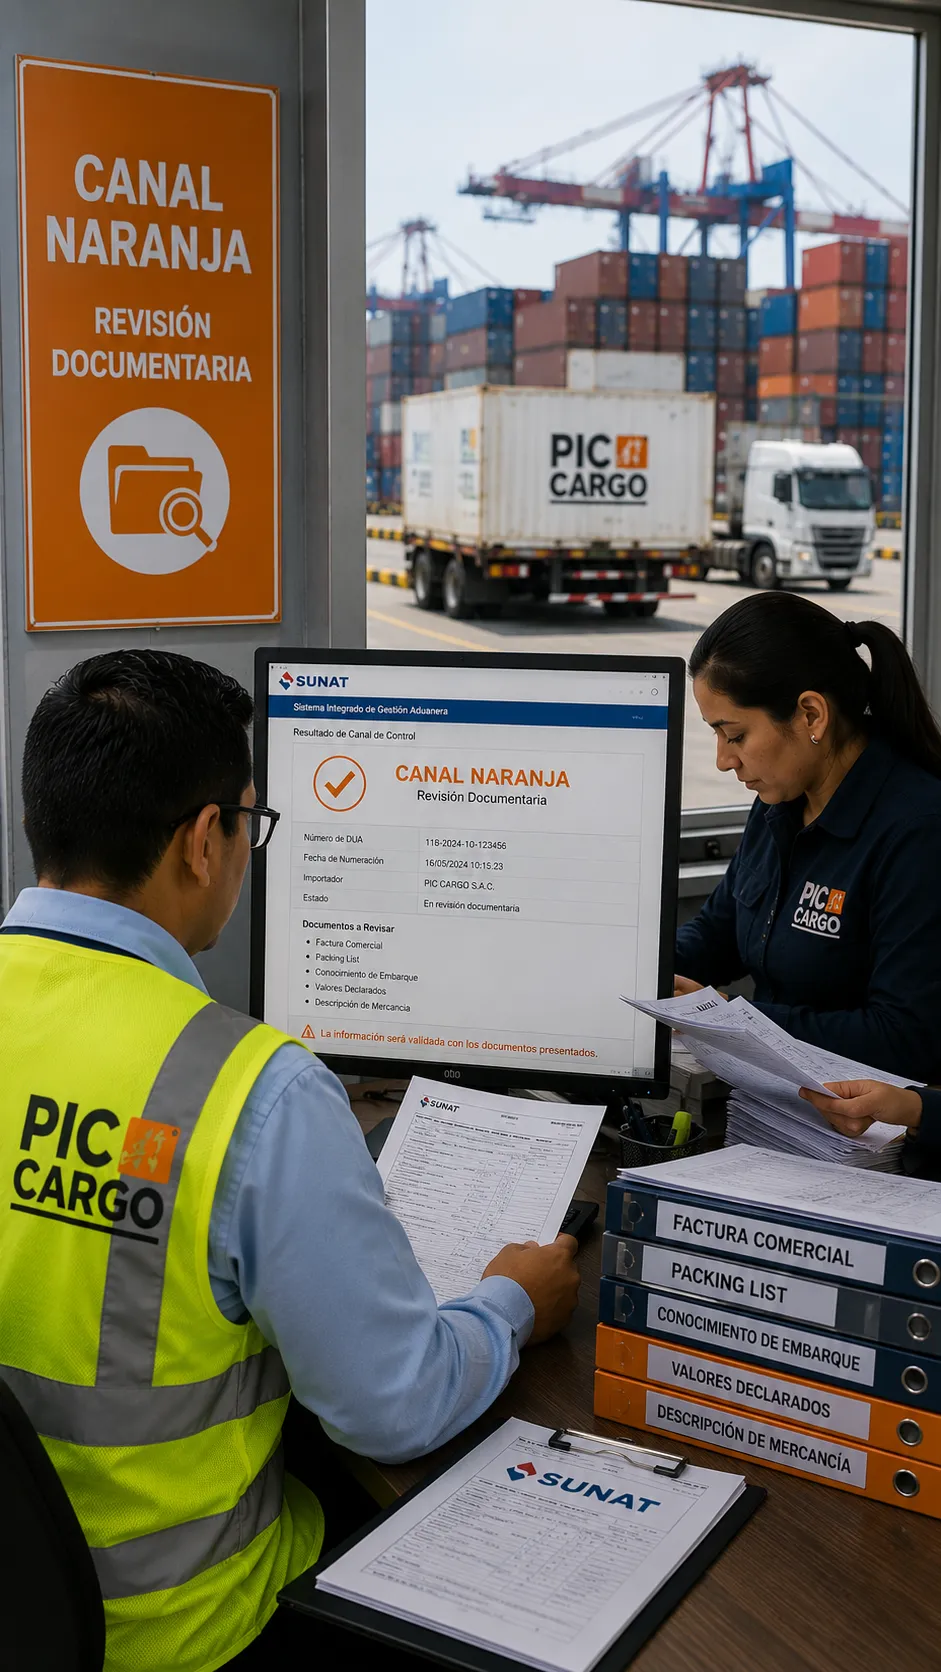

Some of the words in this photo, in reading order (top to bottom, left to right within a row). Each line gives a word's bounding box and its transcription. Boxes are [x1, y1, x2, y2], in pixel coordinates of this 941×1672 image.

[75, 154, 223, 212] CANAL
[47, 215, 252, 274] NARANJA
[95, 304, 210, 339] REVISIÓN
[52, 349, 252, 382] DOCUMENTARIA
[551, 433, 611, 468] PIC
[550, 472, 648, 498] CARGO
[296, 675, 349, 688] SUNAT
[293, 702, 325, 712] Sistema
[326, 703, 364, 714] Integrado
[365, 704, 376, 713] de
[410, 706, 448, 716] Aduanera
[294, 728, 334, 738] Resultado
[336, 729, 346, 738] de
[348, 730, 372, 739] Canal
[374, 731, 384, 740] de
[386, 731, 416, 740] Control
[395, 764, 464, 784] CANAL
[471, 768, 570, 788] NARANJA
[417, 790, 464, 802] Revisión
[468, 792, 547, 806] Documentaria
[304, 833, 333, 842] Número
[334, 835, 344, 843] de
[346, 836, 363, 844] DUA
[304, 854, 326, 862] Fecha
[328, 855, 338, 863] de
[340, 855, 384, 864] Numeración
[425, 859, 468, 869] 16/05/2024
[303, 874, 343, 884] Importador
[424, 880, 438, 888] PIC
[439, 880, 470, 889] CARGO
[472, 882, 495, 891] S.A.C.
[303, 894, 329, 902] Estado
[799, 881, 829, 910] PIC
[424, 900, 434, 908] En
[436, 900, 465, 910] revisión
[467, 902, 520, 913] documentaria
[302, 920, 354, 930] Documentos
[363, 923, 394, 933] Revisar
[794, 906, 840, 933] CARGO
[316, 938, 344, 948] Factura
[346, 940, 383, 950] Comercial
[315, 953, 344, 964] Packing
[347, 955, 359, 963] List
[315, 968, 366, 979] Conocimiento
[368, 971, 378, 979] de
[380, 971, 418, 982] Embarque
[315, 983, 342, 992] Valores
[345, 985, 386, 995] Declarados
[315, 998, 358, 1009] Descripción
[360, 1001, 370, 1009] de
[320, 1029, 331, 1038] La
[334, 1030, 384, 1042] información
[387, 1034, 406, 1043] será
[408, 1036, 445, 1046] validada
[447, 1040, 463, 1048] con
[466, 1039, 479, 1049] los
[482, 1041, 536, 1053] documentos
[540, 1046, 598, 1058] presentados.
[430, 1099, 460, 1113] SUNAT
[20, 1094, 120, 1168] PIC
[13, 1159, 164, 1229] CARGO
[673, 1214, 748, 1245] FACTURA
[753, 1231, 854, 1267] COMERCIAL
[671, 1262, 744, 1293] PACKING
[750, 1280, 787, 1303] LIST
[658, 1306, 757, 1344] CONOCIMIENTO
[761, 1333, 779, 1350] DE
[782, 1338, 860, 1372] EMBARQUE
[671, 1361, 732, 1390] VALORES
[736, 1379, 830, 1418] DECLARADOS
[657, 1404, 744, 1442] DESCRIPCIÓN
[748, 1431, 765, 1448] DE
[770, 1436, 851, 1474] MERCANCÍA
[537, 1472, 661, 1513] SUNAT
